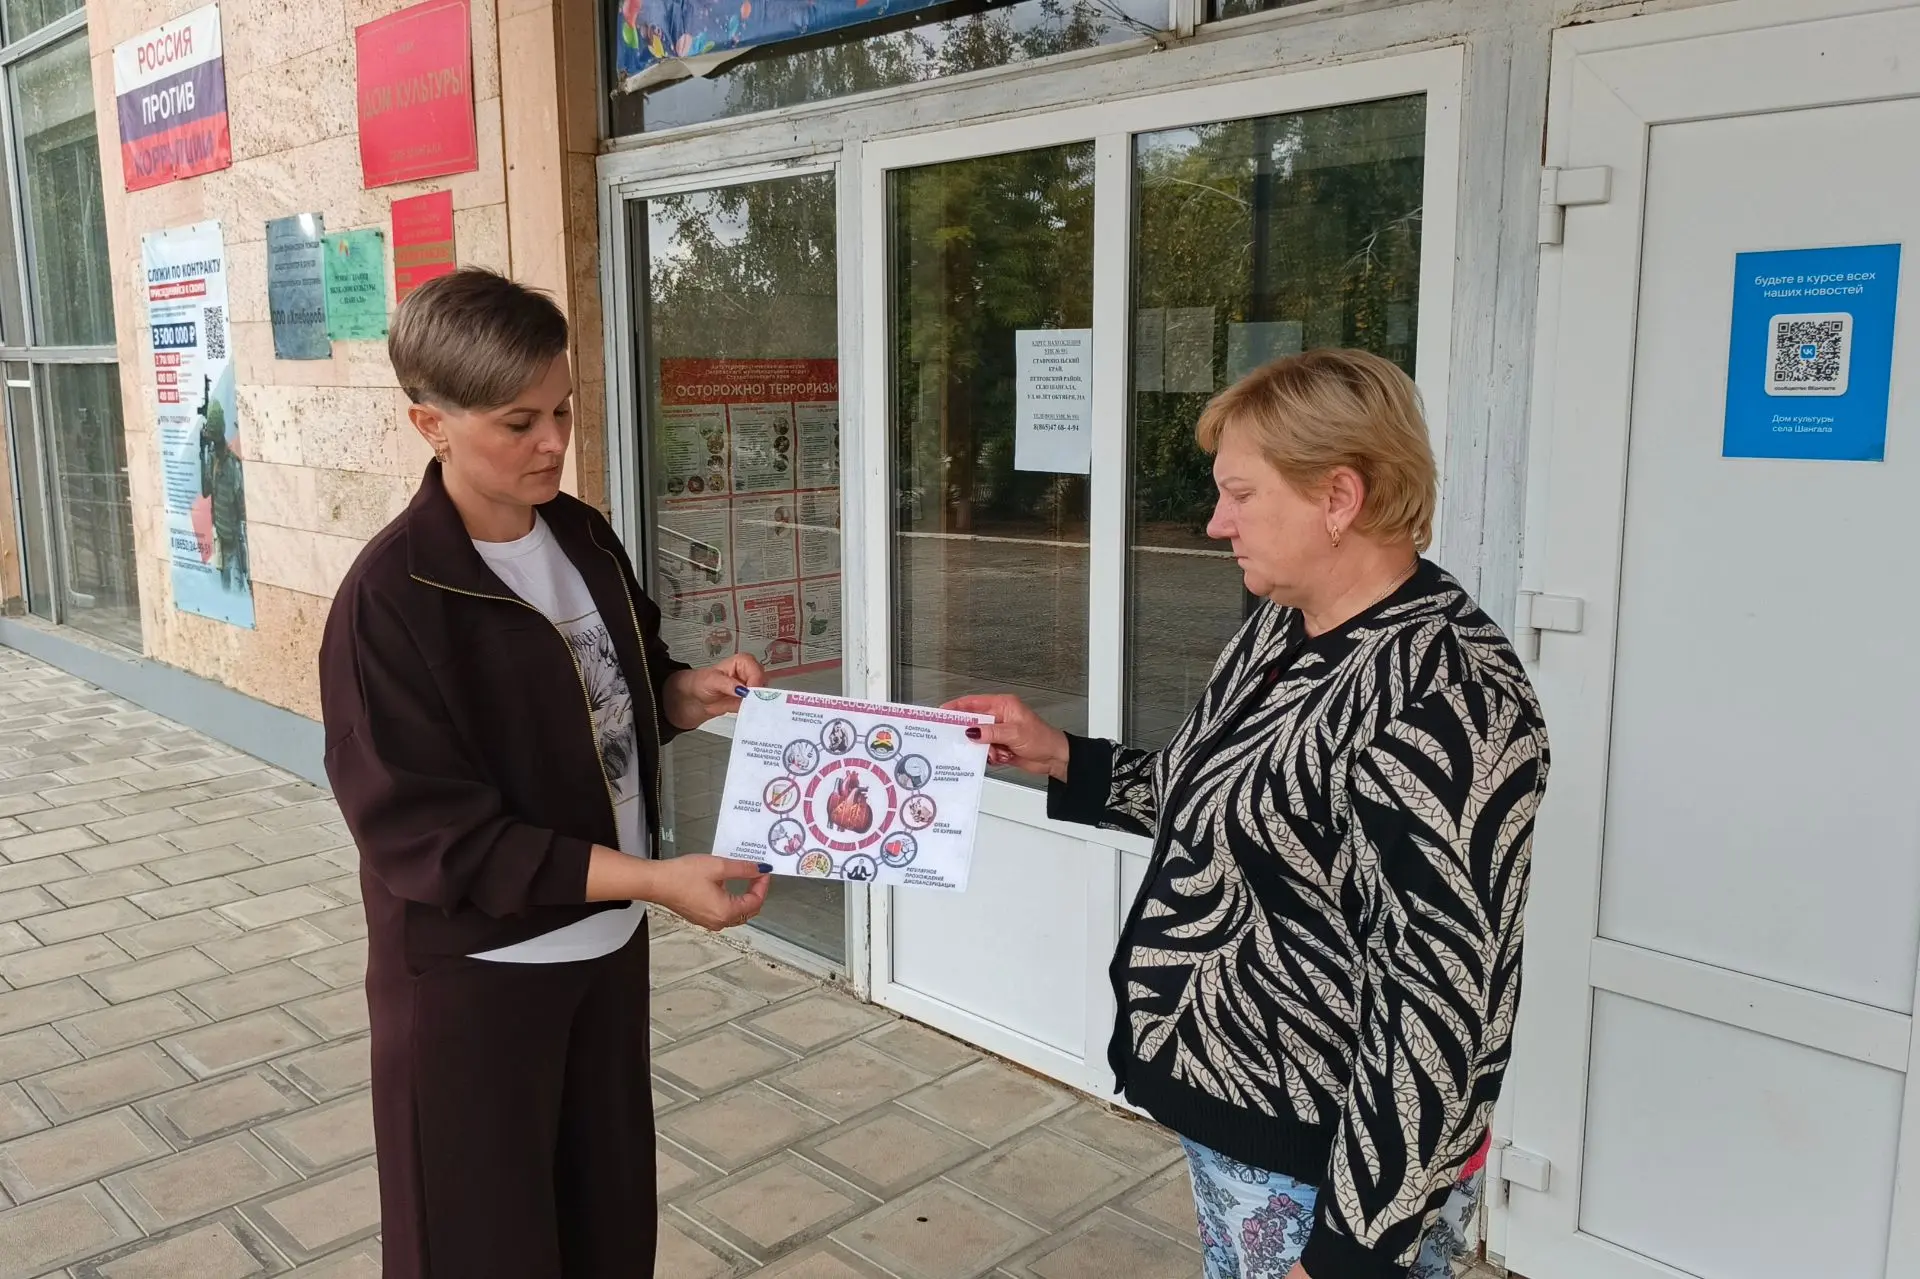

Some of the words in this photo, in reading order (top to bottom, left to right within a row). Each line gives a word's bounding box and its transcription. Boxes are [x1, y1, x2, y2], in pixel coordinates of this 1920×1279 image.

[138, 26, 193, 74] РОССИЯ
[363, 85, 393, 120] ДОМ
[396, 65, 465, 111] КУЛЬТУРЫ
[142, 80, 196, 126] ПРОТИВ
[133, 129, 215, 177] КОРРУПЦИИ
[147, 266, 171, 283] СЛУЖИ
[171, 264, 182, 279] ПО
[182, 258, 222, 278] КОНТРАКТУ
[1754, 275, 1795, 286] будьте
[1806, 274, 1844, 284] курсе
[1847, 272, 1876, 281] всех
[1763, 289, 1802, 298] наших
[1804, 284, 1864, 296] новостей
[153, 328, 159, 346] 3
[160, 327, 174, 346] 500
[174, 326, 188, 345] 000
[675, 383, 766, 398] ОСТОРОЖНО!
[768, 382, 838, 395] ТЕРРОРИЗМ
[1771, 414, 1791, 424] Дом
[1792, 416, 1834, 425] культуры
[1772, 425, 1793, 433] села
[1794, 425, 1833, 433] Шангала
[781, 624, 795, 632] 112
[791, 710, 824, 719] ФИЗИЧЕСКАЯ
[791, 716, 823, 725] АКТИВНОСТЬ
[904, 725, 931, 733] КОНТРОЛЬ
[758, 741, 783, 749] ЛЕКАРСТВ
[753, 747, 773, 755] ТОЛЬКО
[746, 752, 781, 761] НАЗНАЧЕНИЮ
[733, 805, 761, 813] АЛКОГОЛЯ
[741, 841, 767, 850] КОНТРОЛЬ
[735, 847, 762, 855] ГЛЮКОЗЫ
[906, 867, 937, 875] РЕГУЛЯРНОЕ
[904, 872, 944, 881] ПРОХОЖДЕНИЕ
[903, 878, 956, 888] ДИСПАНСЕРИЗАЦИИ
